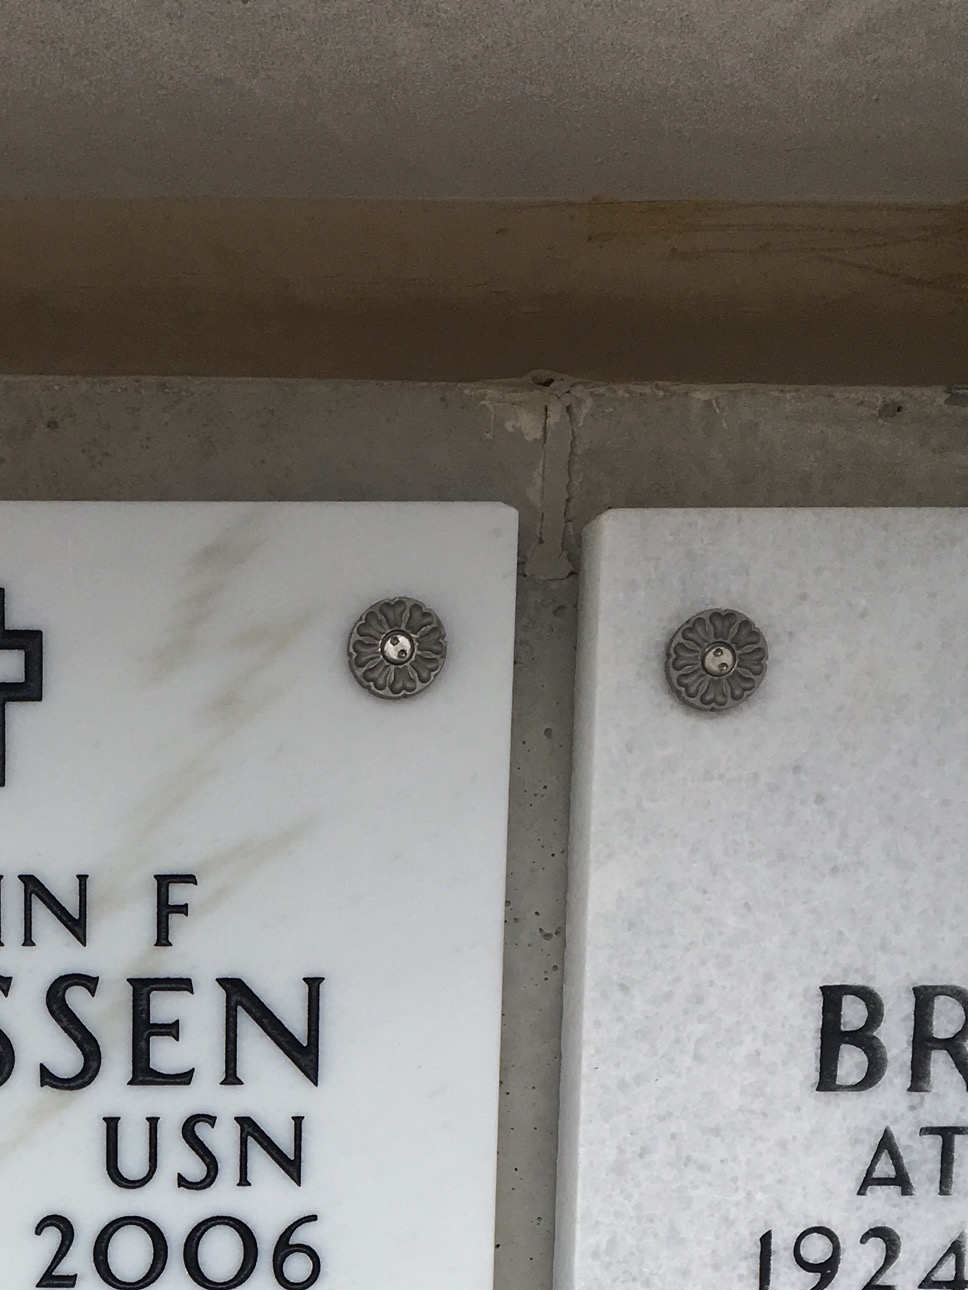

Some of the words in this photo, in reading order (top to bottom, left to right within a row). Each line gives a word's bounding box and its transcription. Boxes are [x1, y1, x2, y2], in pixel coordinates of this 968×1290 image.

[153, 873, 198, 947] F
[815, 984, 968, 1093] BR
[102, 1113, 305, 1191] USN
[856, 1125, 968, 1197] AT
